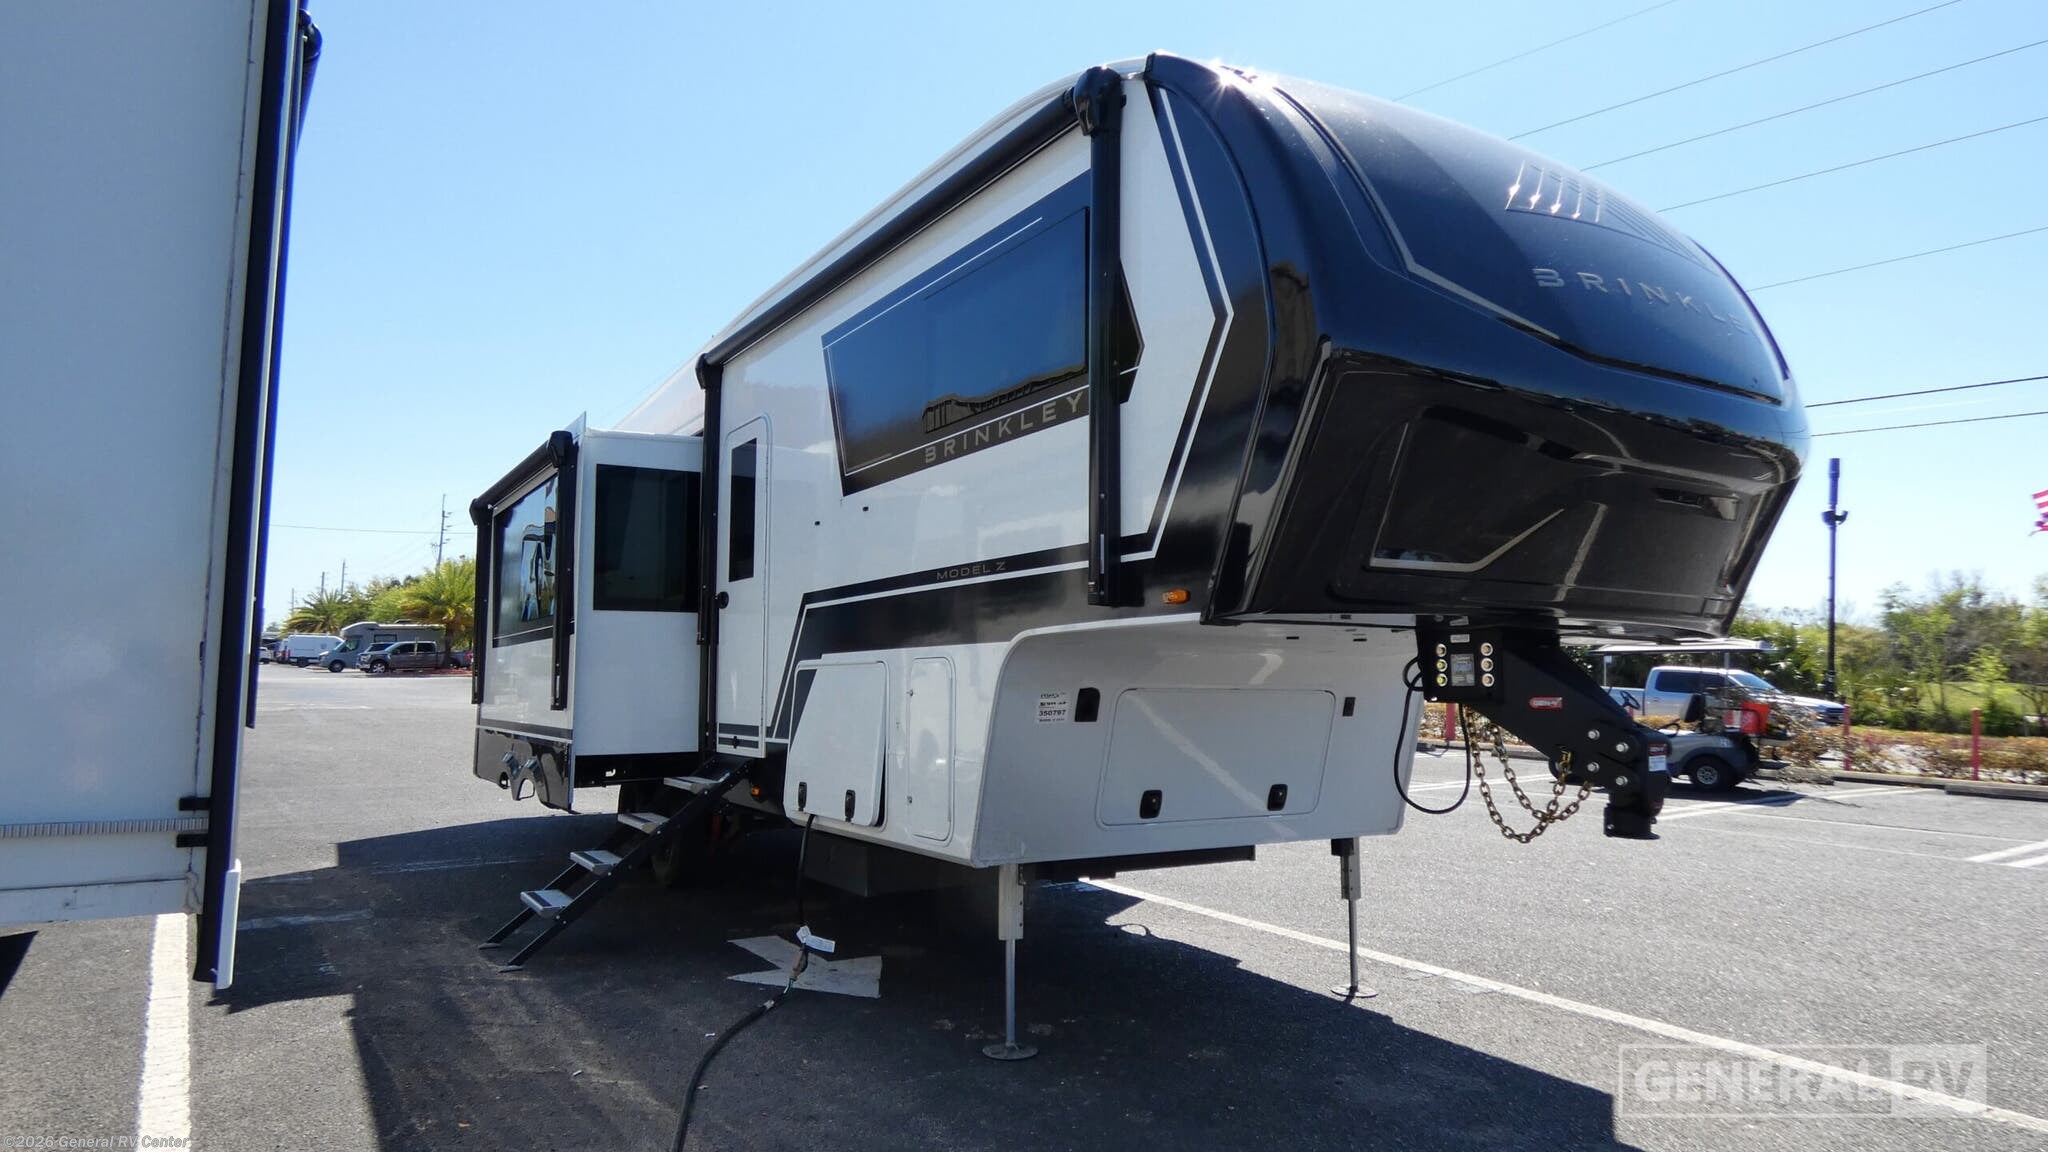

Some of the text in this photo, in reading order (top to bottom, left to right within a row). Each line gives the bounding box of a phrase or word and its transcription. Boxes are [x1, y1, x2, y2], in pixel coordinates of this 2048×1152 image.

[1532, 267, 1752, 335] BRINKLE
[925, 391, 1083, 463] BRINKLEY
[936, 561, 1006, 580] MODEL Z
